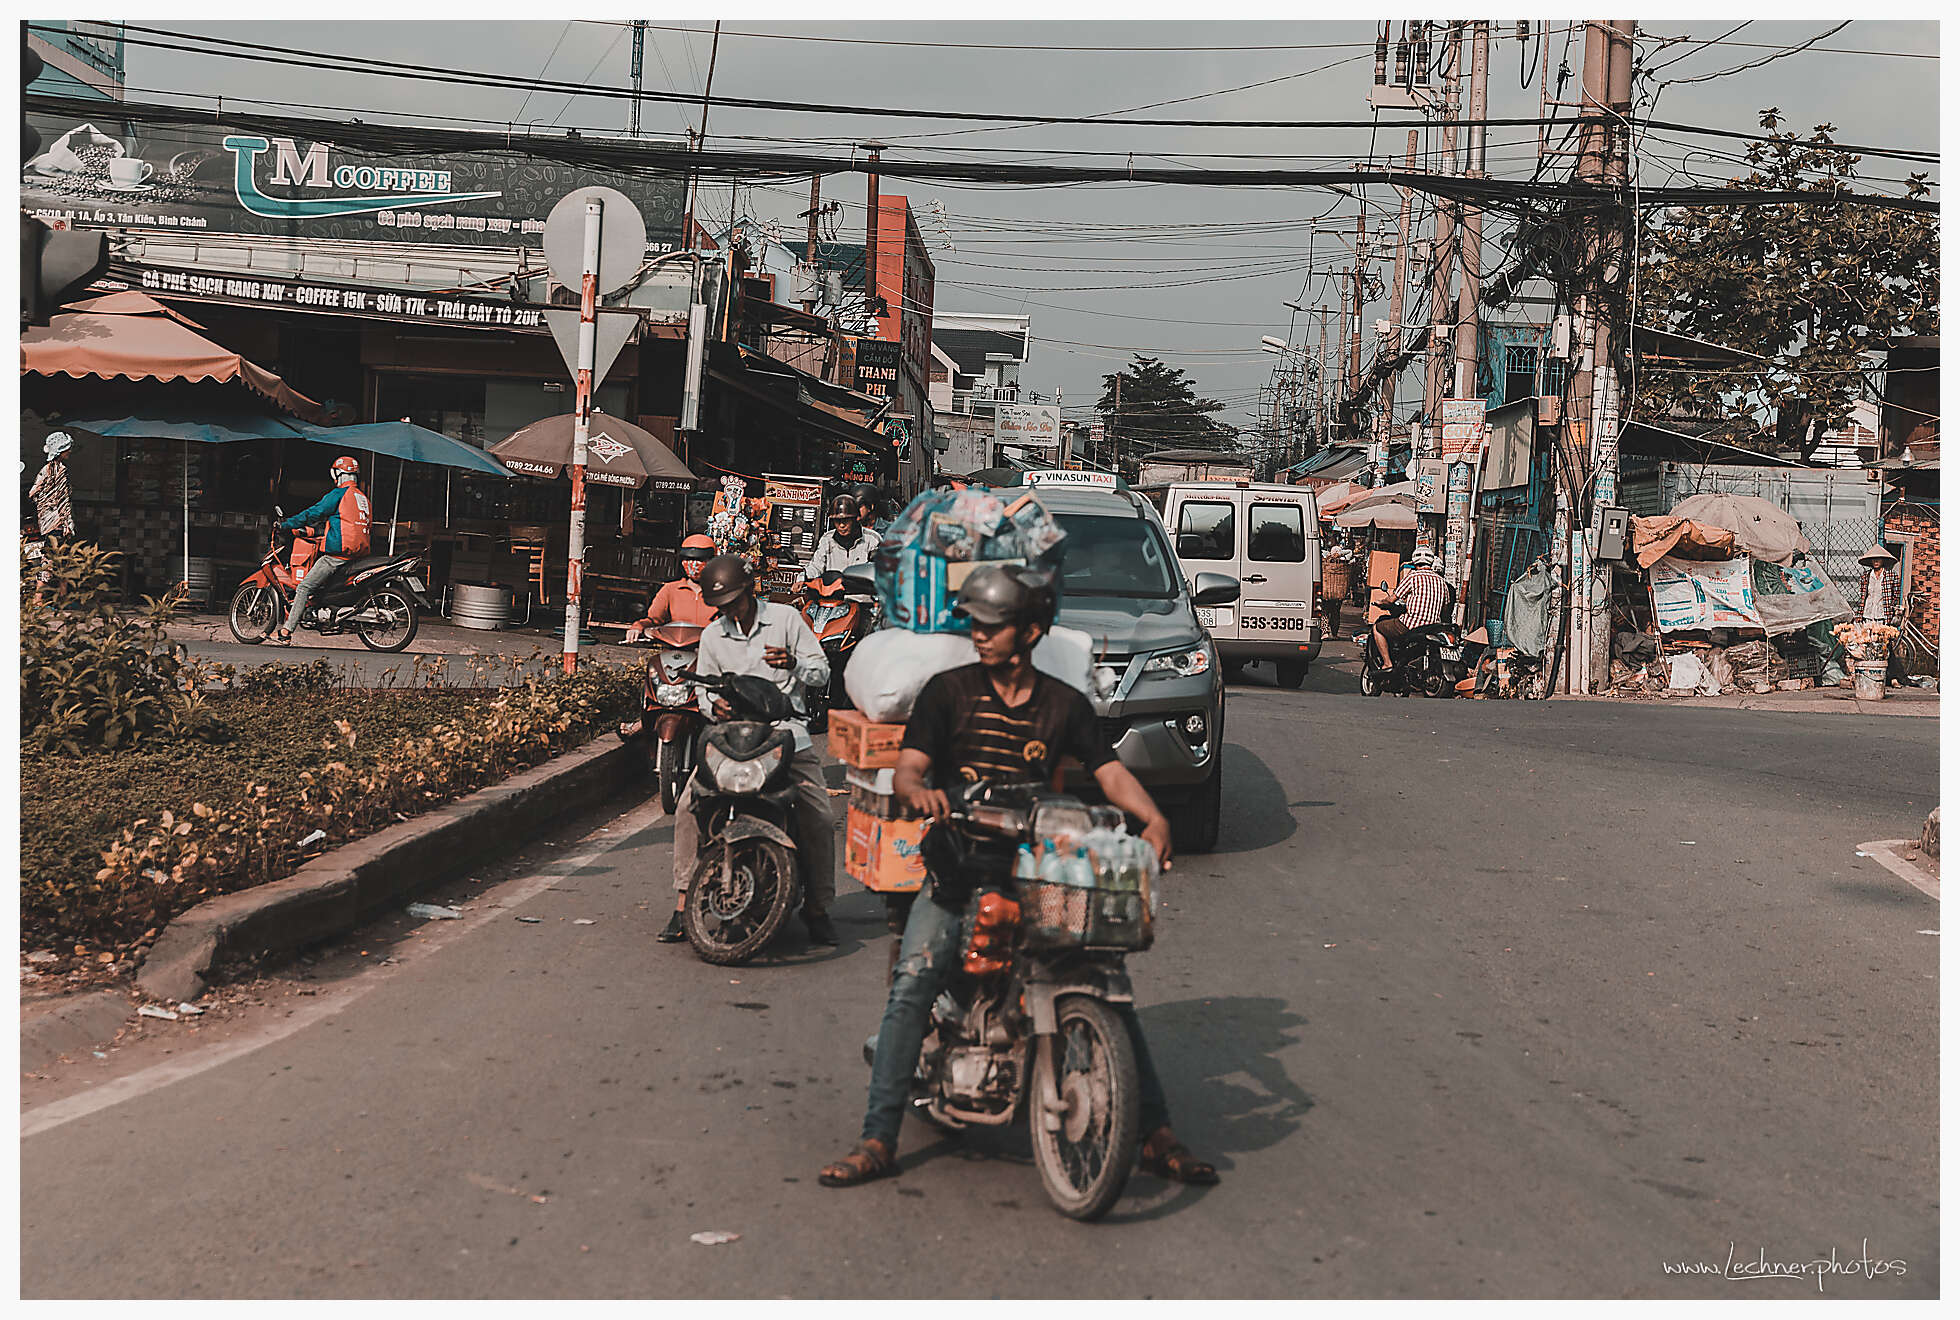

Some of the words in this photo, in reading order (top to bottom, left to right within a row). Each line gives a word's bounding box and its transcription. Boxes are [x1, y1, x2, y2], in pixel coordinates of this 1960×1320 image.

[334, 166, 451, 193] COFFEE
[117, 212, 133, 224] Tân
[179, 216, 208, 228] Chánh
[377, 210, 396, 227] Cà
[397, 211, 422, 228] phê
[423, 214, 454, 232] sạch
[455, 217, 486, 232] rang
[487, 219, 511, 234] xay
[661, 243, 673, 254] 27
[142, 269, 160, 288] CÀ
[162, 271, 187, 291] PHÊ
[189, 275, 224, 296] SẠCH
[226, 279, 260, 299] RANG
[262, 283, 286, 301] XAY
[295, 286, 340, 308] COFFEE
[342, 289, 366, 311] 15K
[376, 292, 402, 314] SỮA
[404, 297, 426, 316] 17K
[436, 298, 465, 320] TRÁI
[467, 301, 494, 322] CÂY
[495, 305, 512, 325] TÔ
[513, 309, 541, 327] 20K
[858, 365, 897, 381] THANH
[865, 382, 887, 396] PHI
[505, 460, 554, 475] 0789.22.44.66
[1045, 472, 1091, 483] VINASUN
[1090, 474, 1113, 484] TAXI
[655, 480, 691, 492] 0789.22.44.66
[775, 487, 798, 500] BÁNH
[1240, 615, 1305, 631] 53S-3308
